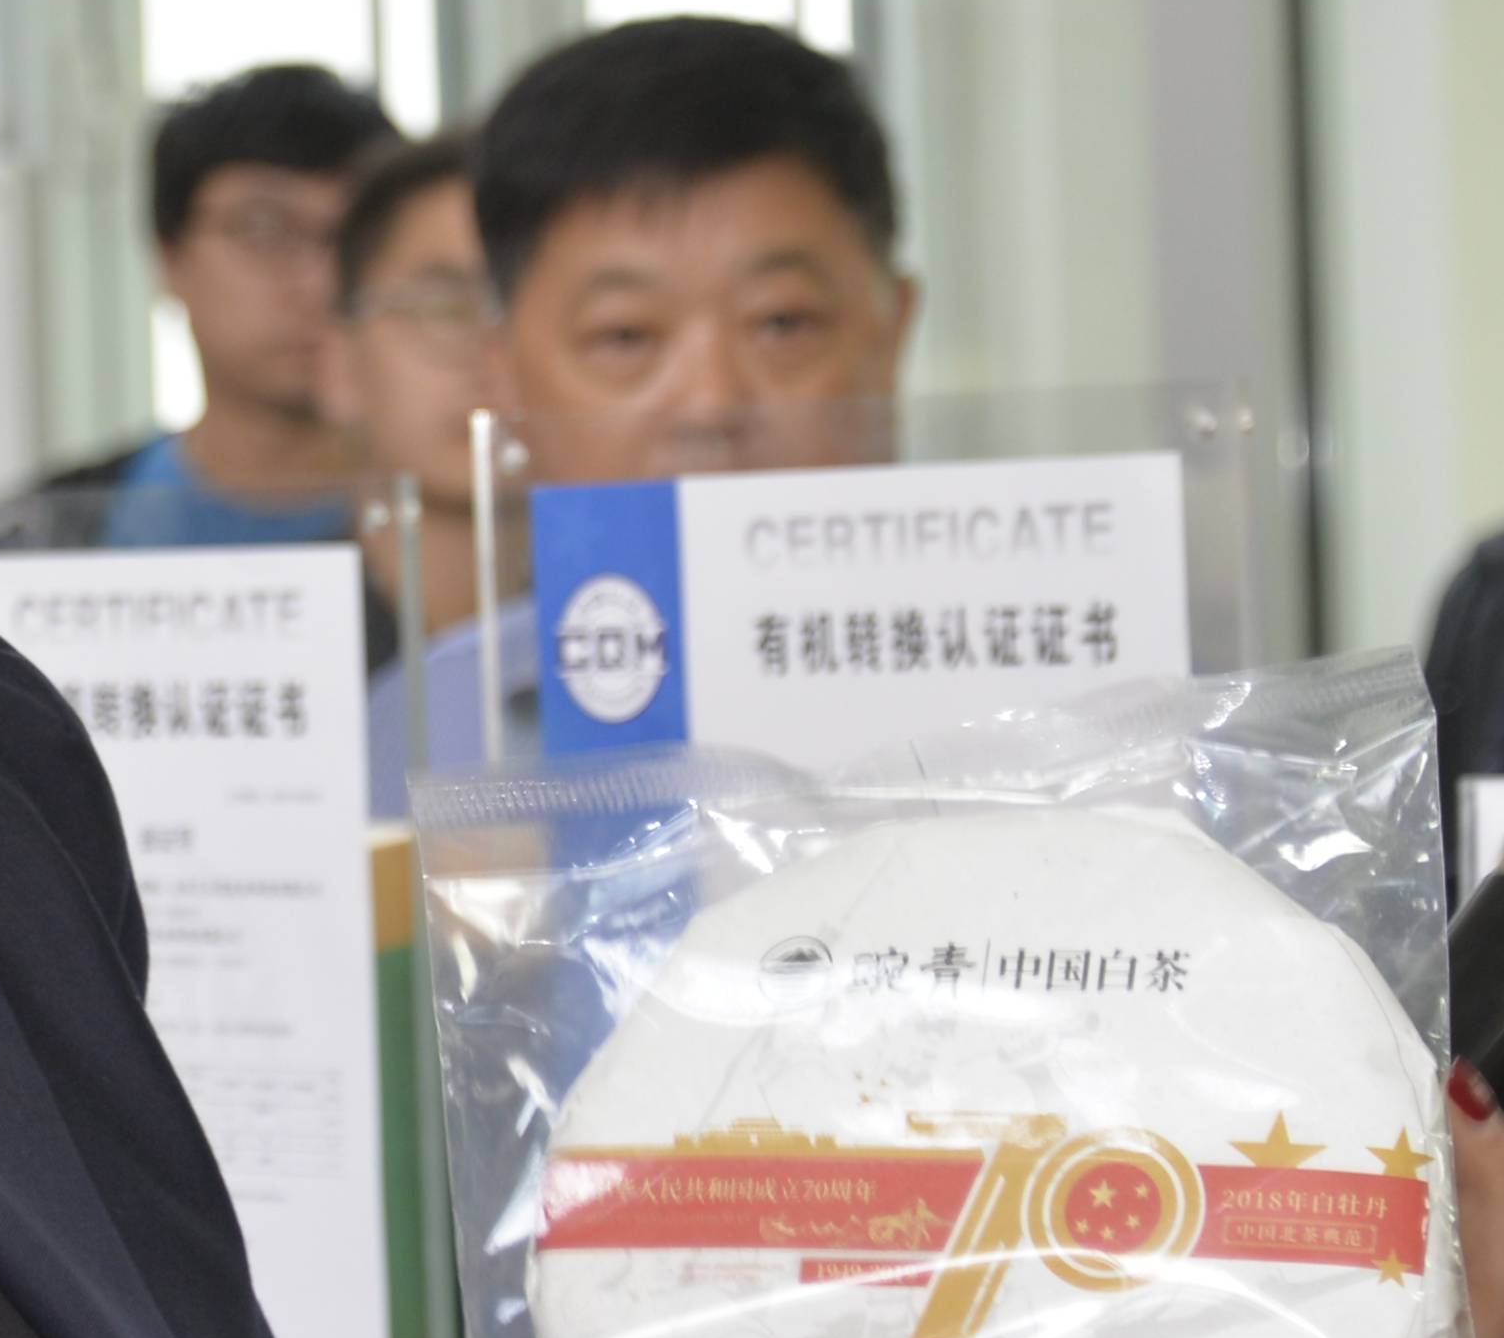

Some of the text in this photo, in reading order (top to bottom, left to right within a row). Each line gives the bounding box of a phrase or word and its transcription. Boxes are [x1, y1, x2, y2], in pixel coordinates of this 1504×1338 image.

[745, 501, 1116, 569] CERTIFICATE
[754, 603, 1120, 677] 有机转换认证证书
[997, 947, 1192, 994] 中国白茶
[1221, 1189, 1389, 1220] 2018年白牡丹
